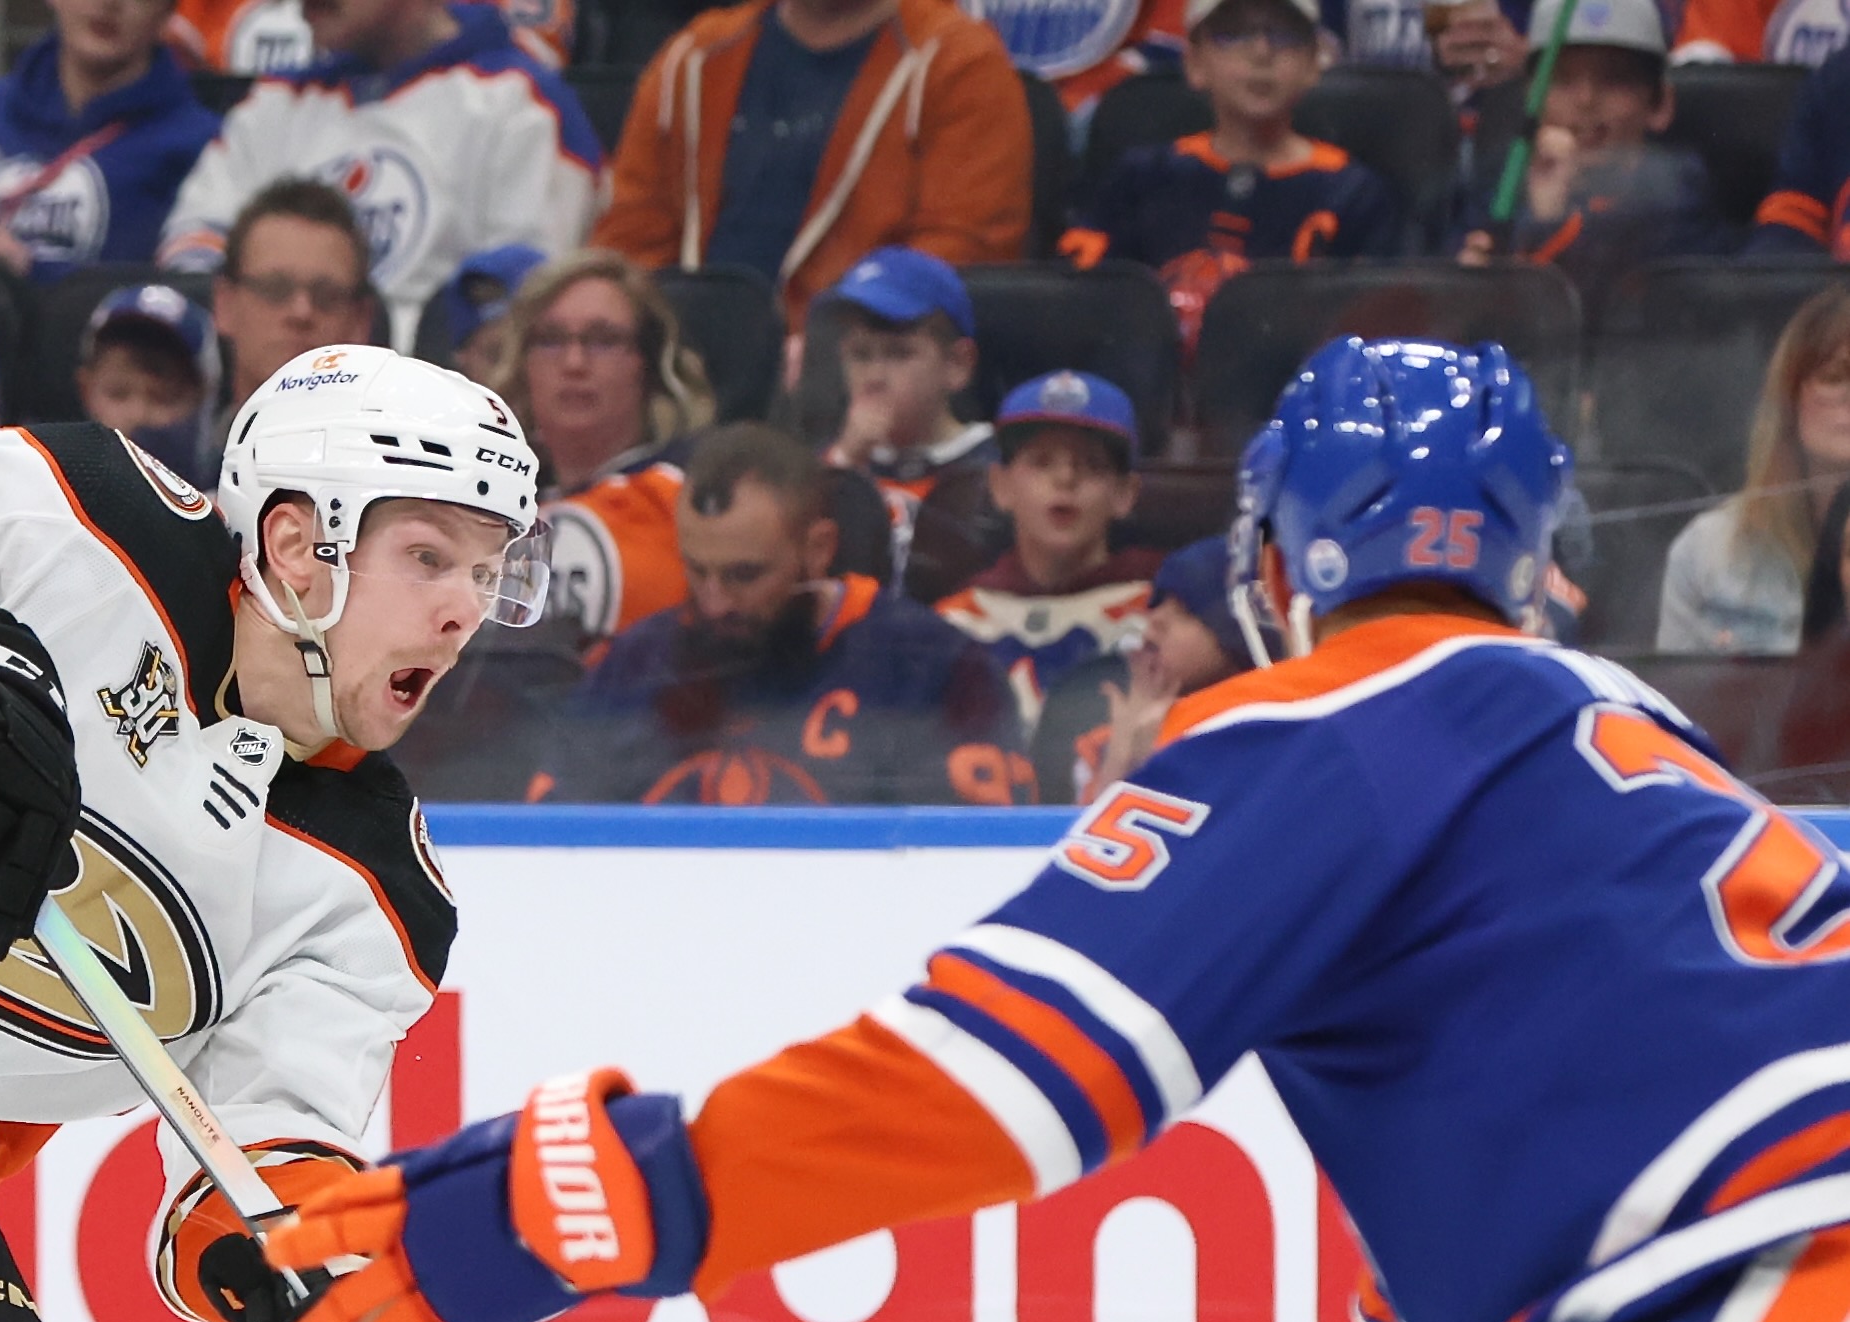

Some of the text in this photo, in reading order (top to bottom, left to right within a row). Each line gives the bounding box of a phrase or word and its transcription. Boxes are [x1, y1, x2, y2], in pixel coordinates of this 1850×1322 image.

[275, 369, 359, 393] Navigator
[483, 397, 508, 425] 5
[475, 446, 532, 477] CCM
[1407, 505, 1484, 569] 25
[120, 668, 174, 744] 30
[802, 687, 859, 760] C
[235, 741, 267, 754] NHL
[1049, 779, 1212, 890] 5
[176, 1086, 220, 1144] NANOLITE
